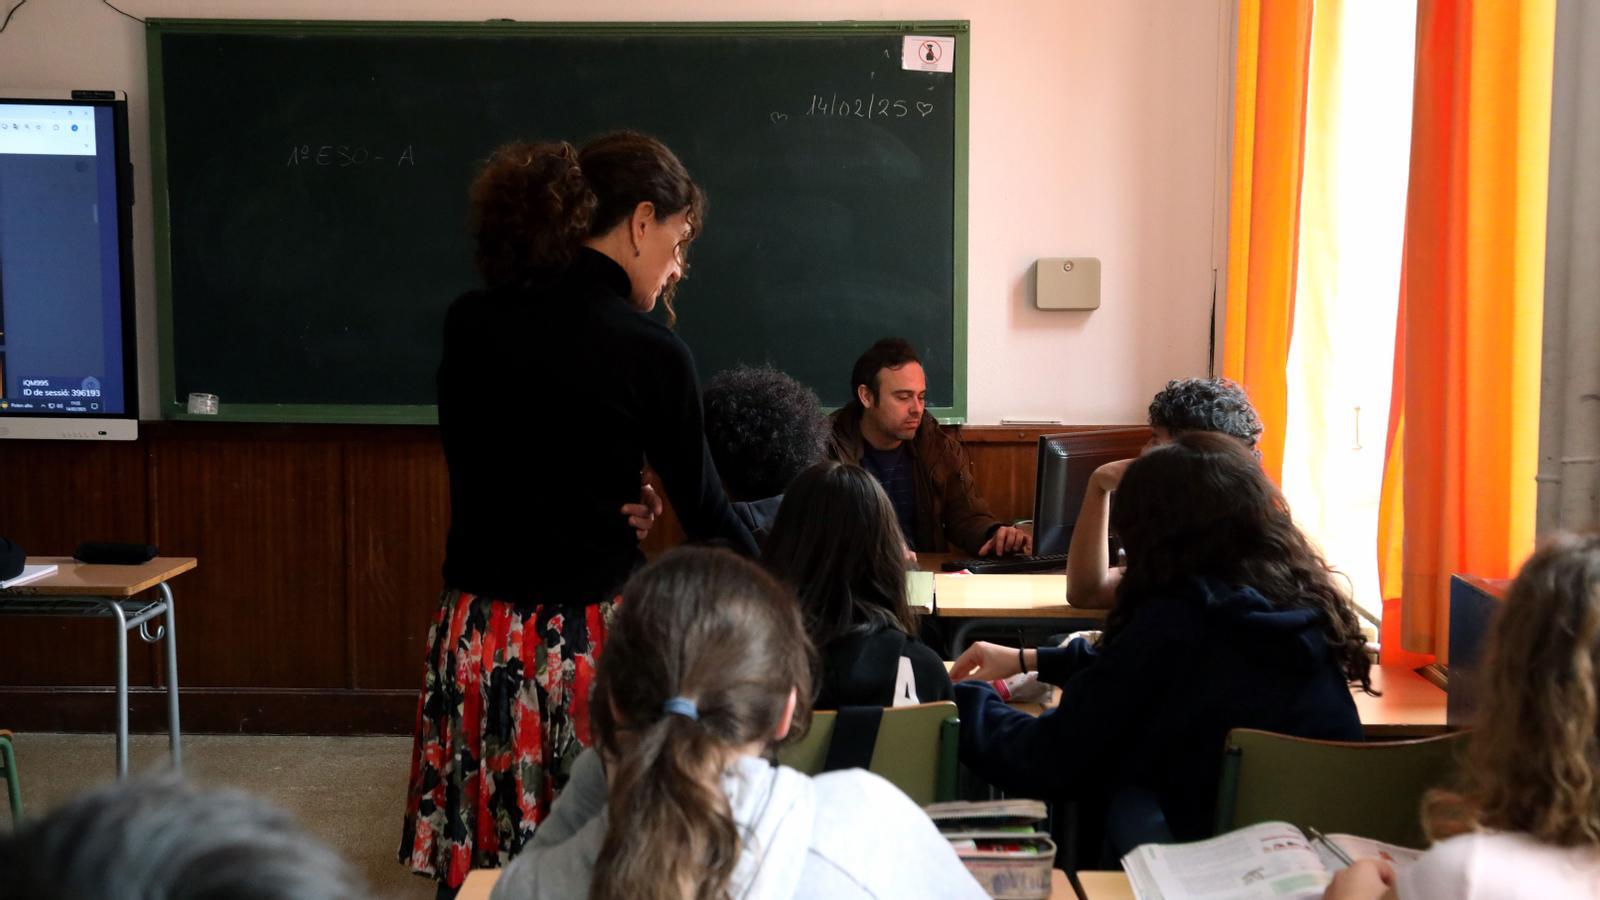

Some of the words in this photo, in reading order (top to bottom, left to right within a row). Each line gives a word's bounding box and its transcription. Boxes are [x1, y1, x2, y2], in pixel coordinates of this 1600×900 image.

[806, 92, 908, 119] 14/02/25
[315, 145, 369, 168] ESO
[397, 144, 415, 167] A
[23, 388, 33, 396] ID
[33, 388, 43, 396] de
[44, 388, 70, 397] sessió:
[71, 389, 101, 397] 396193
